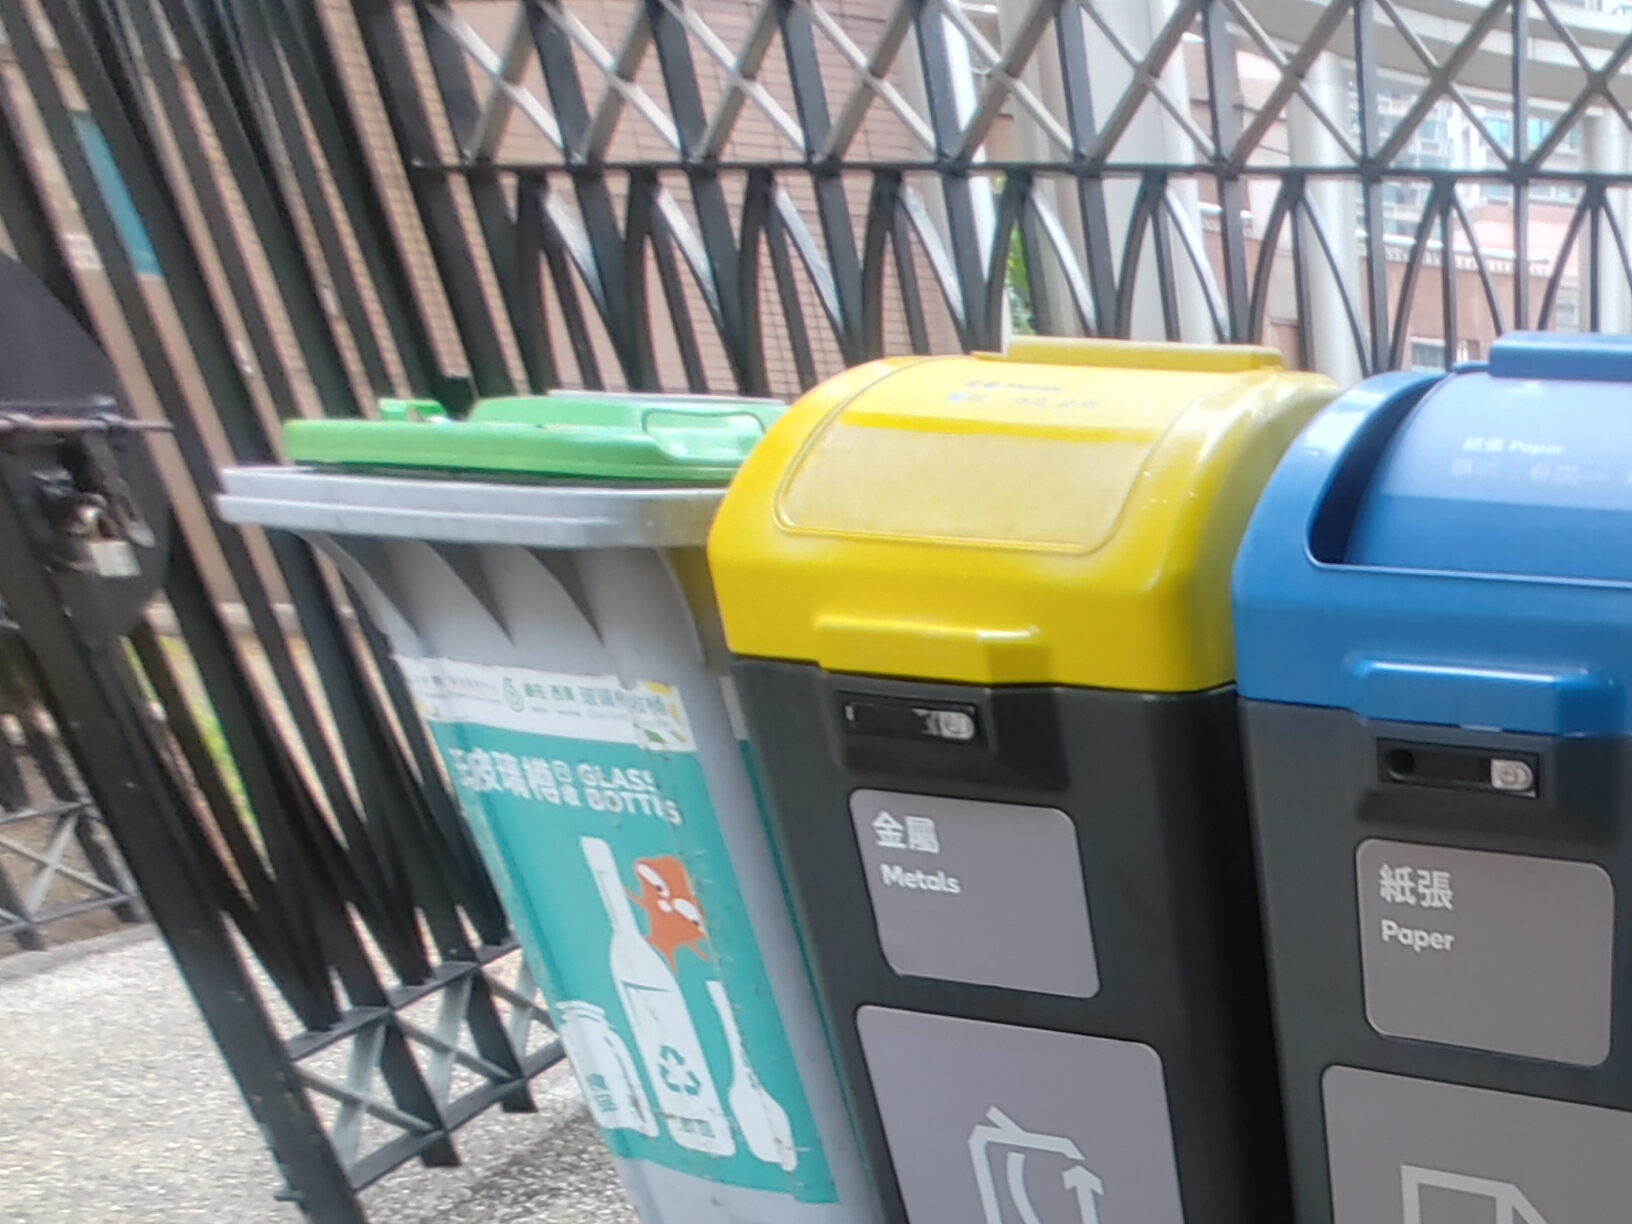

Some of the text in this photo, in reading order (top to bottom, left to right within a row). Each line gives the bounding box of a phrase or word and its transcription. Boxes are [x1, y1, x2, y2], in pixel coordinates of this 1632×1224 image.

[871, 810, 941, 854] 金屬
[880, 863, 962, 894] Metals
[1378, 863, 1453, 910] 紙張
[1380, 918, 1455, 953] Paper
